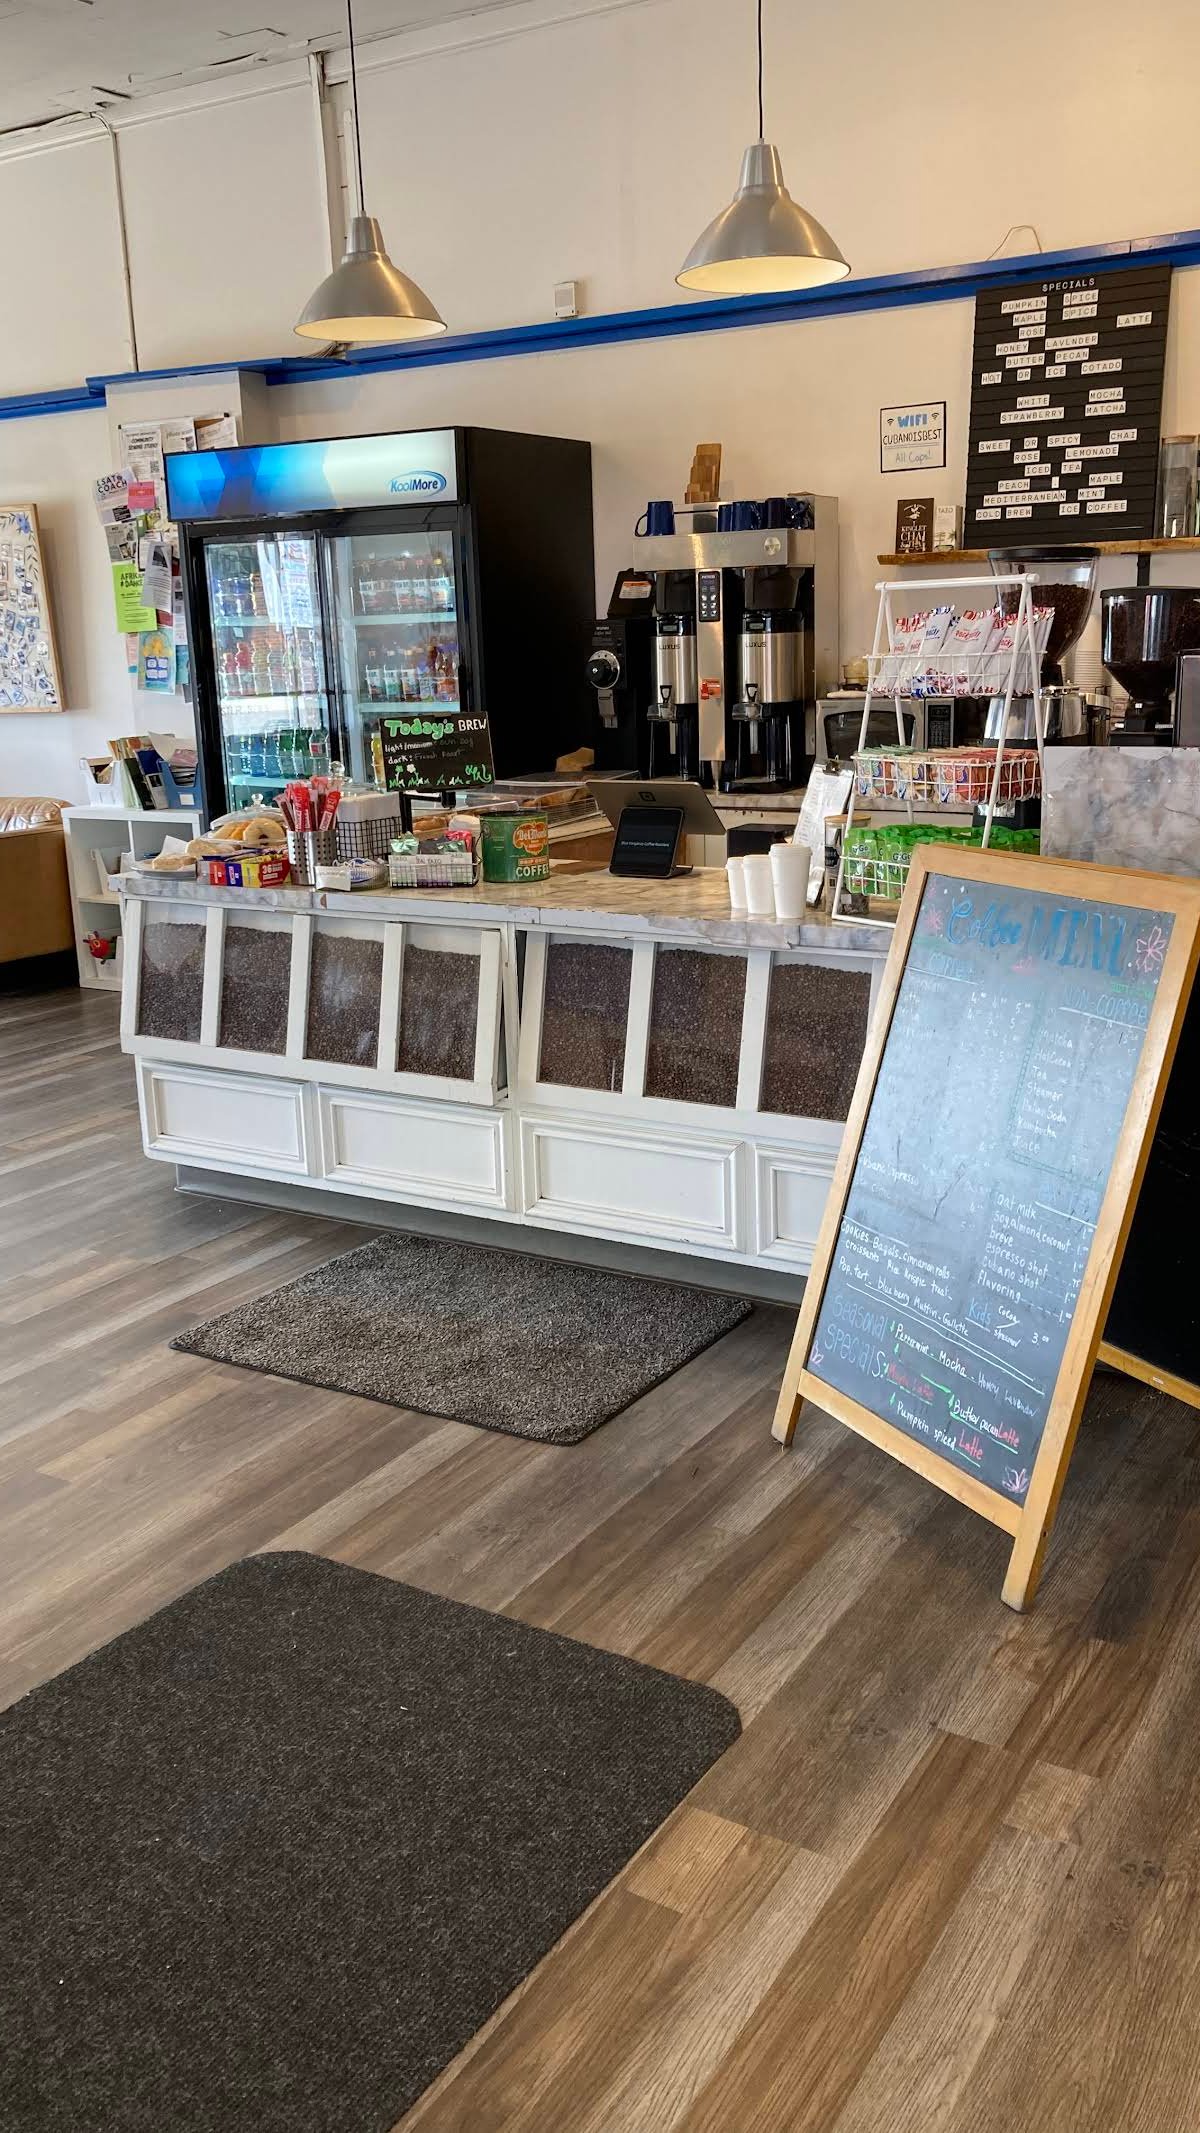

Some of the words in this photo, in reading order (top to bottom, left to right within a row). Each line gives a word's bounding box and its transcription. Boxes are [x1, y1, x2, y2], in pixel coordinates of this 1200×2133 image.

[1042, 278, 1095, 292] SPECIALS
[1002, 300, 1046, 311] PUMPKIN
[1064, 292, 1097, 304] SPICE
[1014, 314, 1045, 323] MAPLE
[1064, 307, 1096, 317] SPICE
[1020, 328, 1044, 336] ROSE
[1118, 315, 1150, 325] LATTE
[997, 344, 1028, 353] HONEY
[1007, 356, 1043, 366] BUTTER
[1056, 351, 1088, 360] PECAN
[982, 374, 1001, 382] HOT
[1018, 370, 1030, 379] OR
[1047, 367, 1065, 376] ICE
[1082, 361, 1121, 372] COTADO
[1018, 397, 1049, 406] WHITE
[1090, 390, 1122, 399] MOCHA
[1001, 410, 1063, 421] STRAWBERRY
[1087, 404, 1125, 414] MATCHA
[980, 442, 1010, 451] SWEET
[1025, 439, 1037, 447] OR
[1048, 436, 1080, 445] SPICY
[1111, 431, 1136, 440] CHAI
[1015, 453, 1039, 461] ROSE
[1067, 447, 1118, 457] LEMONADE
[1026, 466, 1050, 474] ICED
[1063, 463, 1081, 471] TEA
[97, 476, 116, 486] LSAT
[98, 480, 127, 493] COACH
[390, 478, 438, 494] KoolMore
[999, 482, 1029, 490] PEACH
[1090, 475, 1121, 483] MAPLE
[985, 493, 1065, 504] MEDITERRANEAN
[1079, 490, 1104, 498] MINT
[977, 510, 1000, 518] COLD
[1007, 508, 1031, 516] BREW
[1061, 505, 1078, 513] ICE
[1088, 502, 1126, 512] COFFEE
[384, 718, 454, 740] Today's
[458, 719, 487, 731] BREW
[262, 864, 271, 874] 36
[968, 1298, 992, 1325] Kids
[938, 1350, 967, 1377] Mocha
[897, 1401, 929, 1433] Pumpkin
[958, 1429, 984, 1460] Latte
[998, 1424, 1020, 1447] Latte
